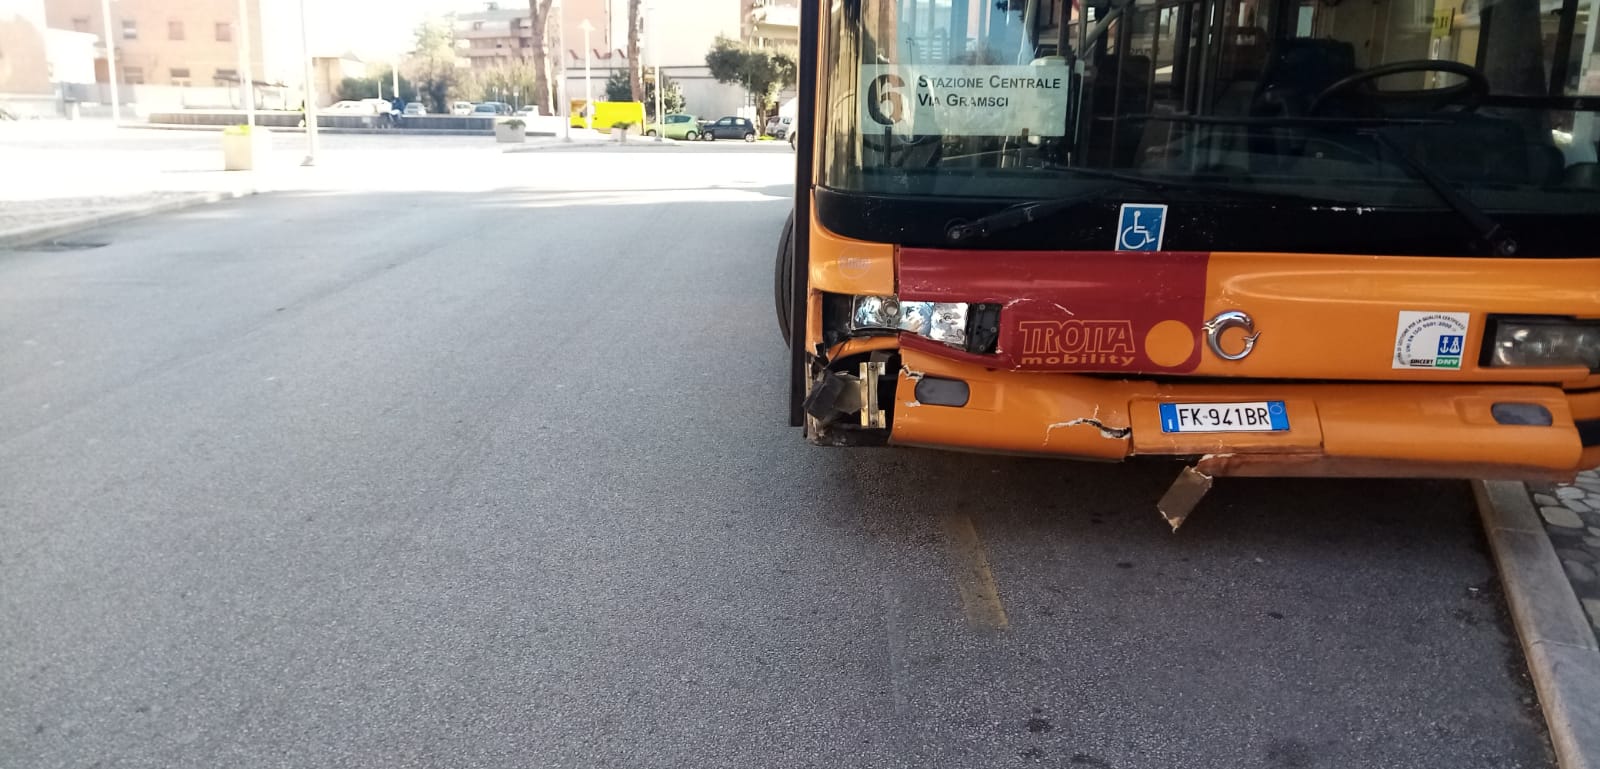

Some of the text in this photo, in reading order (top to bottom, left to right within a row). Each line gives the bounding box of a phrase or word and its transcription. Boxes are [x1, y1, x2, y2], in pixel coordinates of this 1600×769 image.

[918, 75, 1061, 89] STAZIONE CENTRALE
[867, 74, 905, 125] 6
[918, 93, 1009, 107] VIA GRAMSCI
[1019, 319, 1136, 354] TROTTA
[1021, 354, 1136, 367] mobility
